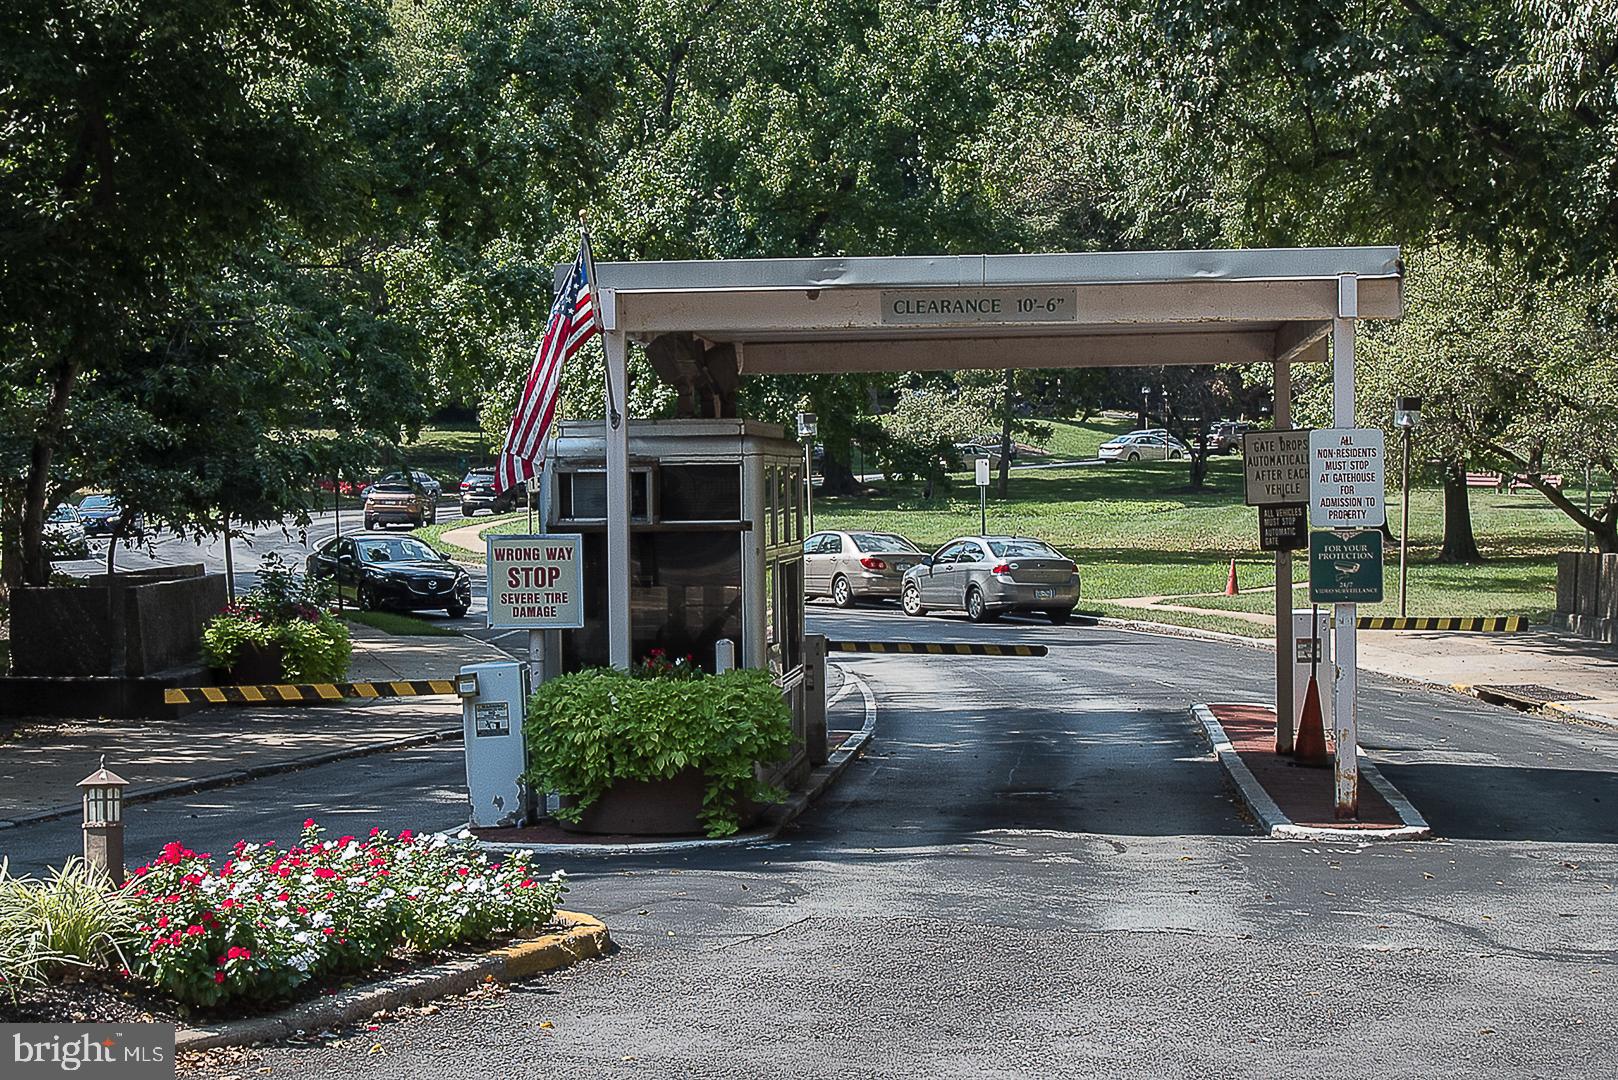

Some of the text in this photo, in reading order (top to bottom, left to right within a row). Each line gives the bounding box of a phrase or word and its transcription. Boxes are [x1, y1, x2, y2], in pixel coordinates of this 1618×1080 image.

[893, 299, 1001, 314] CLEARANCE
[1254, 439, 1308, 452] GATE DROPS
[1340, 436, 1353, 445] ALL
[1248, 454, 1310, 467] AUTOMATICALL
[1325, 461, 1369, 470] MUST STOP
[1255, 468, 1310, 481] AFTER EACH
[1320, 473, 1375, 483] AT GATEHOUSE
[1265, 483, 1301, 495] VEHICLE
[1340, 486, 1354, 495] FOR
[1320, 497, 1375, 507] ADMISSION TO
[1264, 508, 1302, 518] ALL VEHICLES
[1328, 510, 1367, 519] PROPERTY
[1281, 517, 1296, 526] STOP
[1265, 537, 1279, 546] GATE
[1343, 544, 1368, 552] YOUR
[494, 548, 573, 561] WRONG WAY
[1318, 552, 1374, 560] PROTECTION
[507, 567, 560, 588] STOP
[501, 593, 568, 604] SEVERE TIRE
[512, 607, 557, 618] DAMAGE
